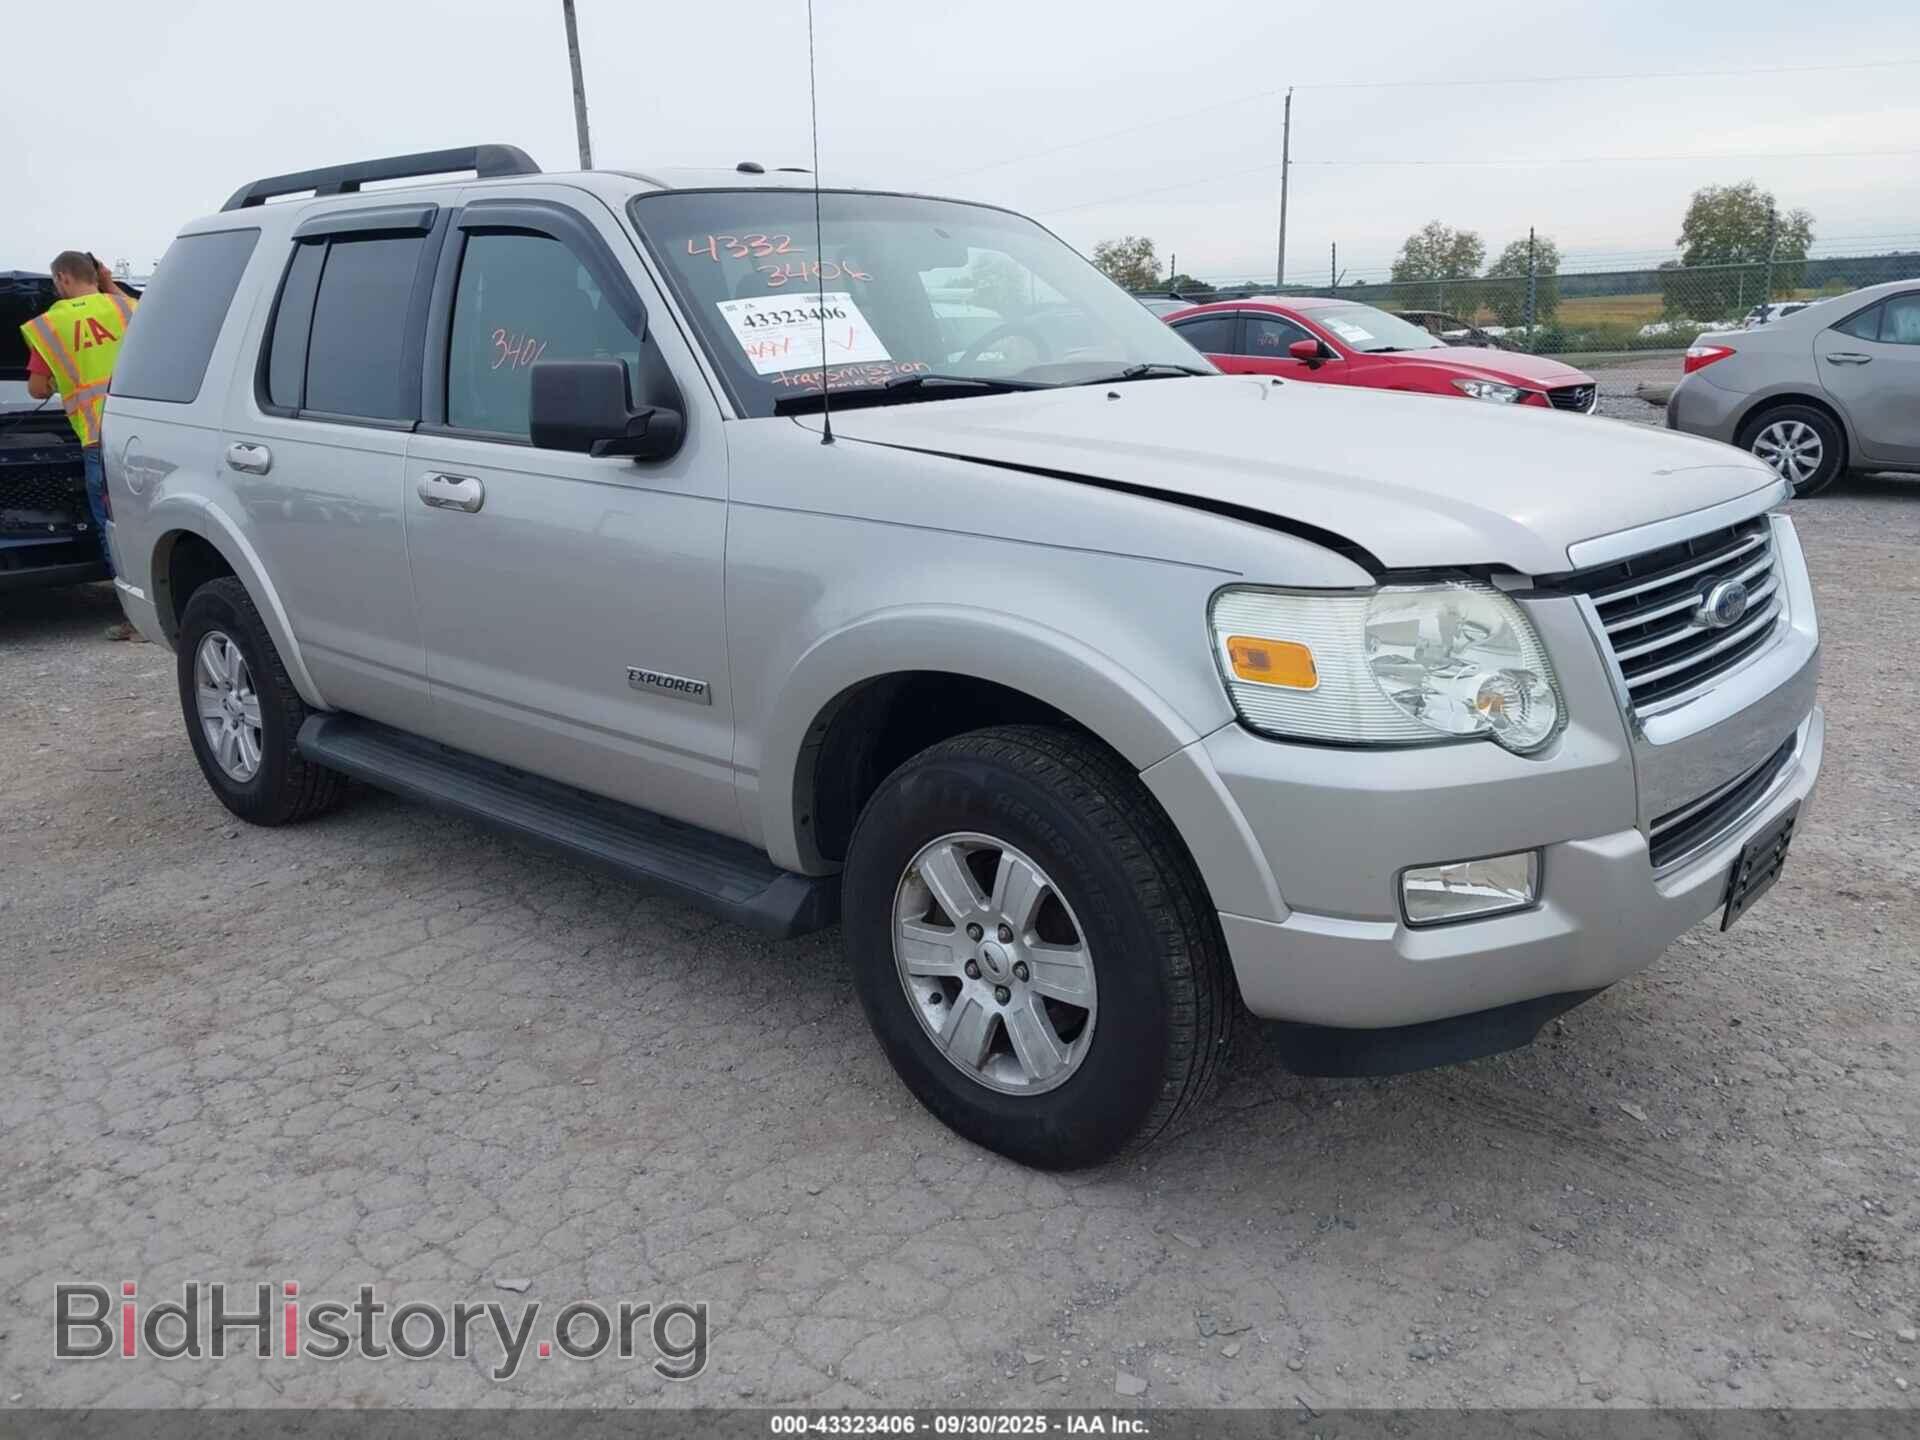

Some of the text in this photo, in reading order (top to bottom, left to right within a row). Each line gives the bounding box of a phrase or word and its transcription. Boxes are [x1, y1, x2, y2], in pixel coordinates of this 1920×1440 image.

[687, 234, 805, 262] 4332
[743, 306, 847, 329] 43323406
[627, 669, 705, 695] EXPLORER
